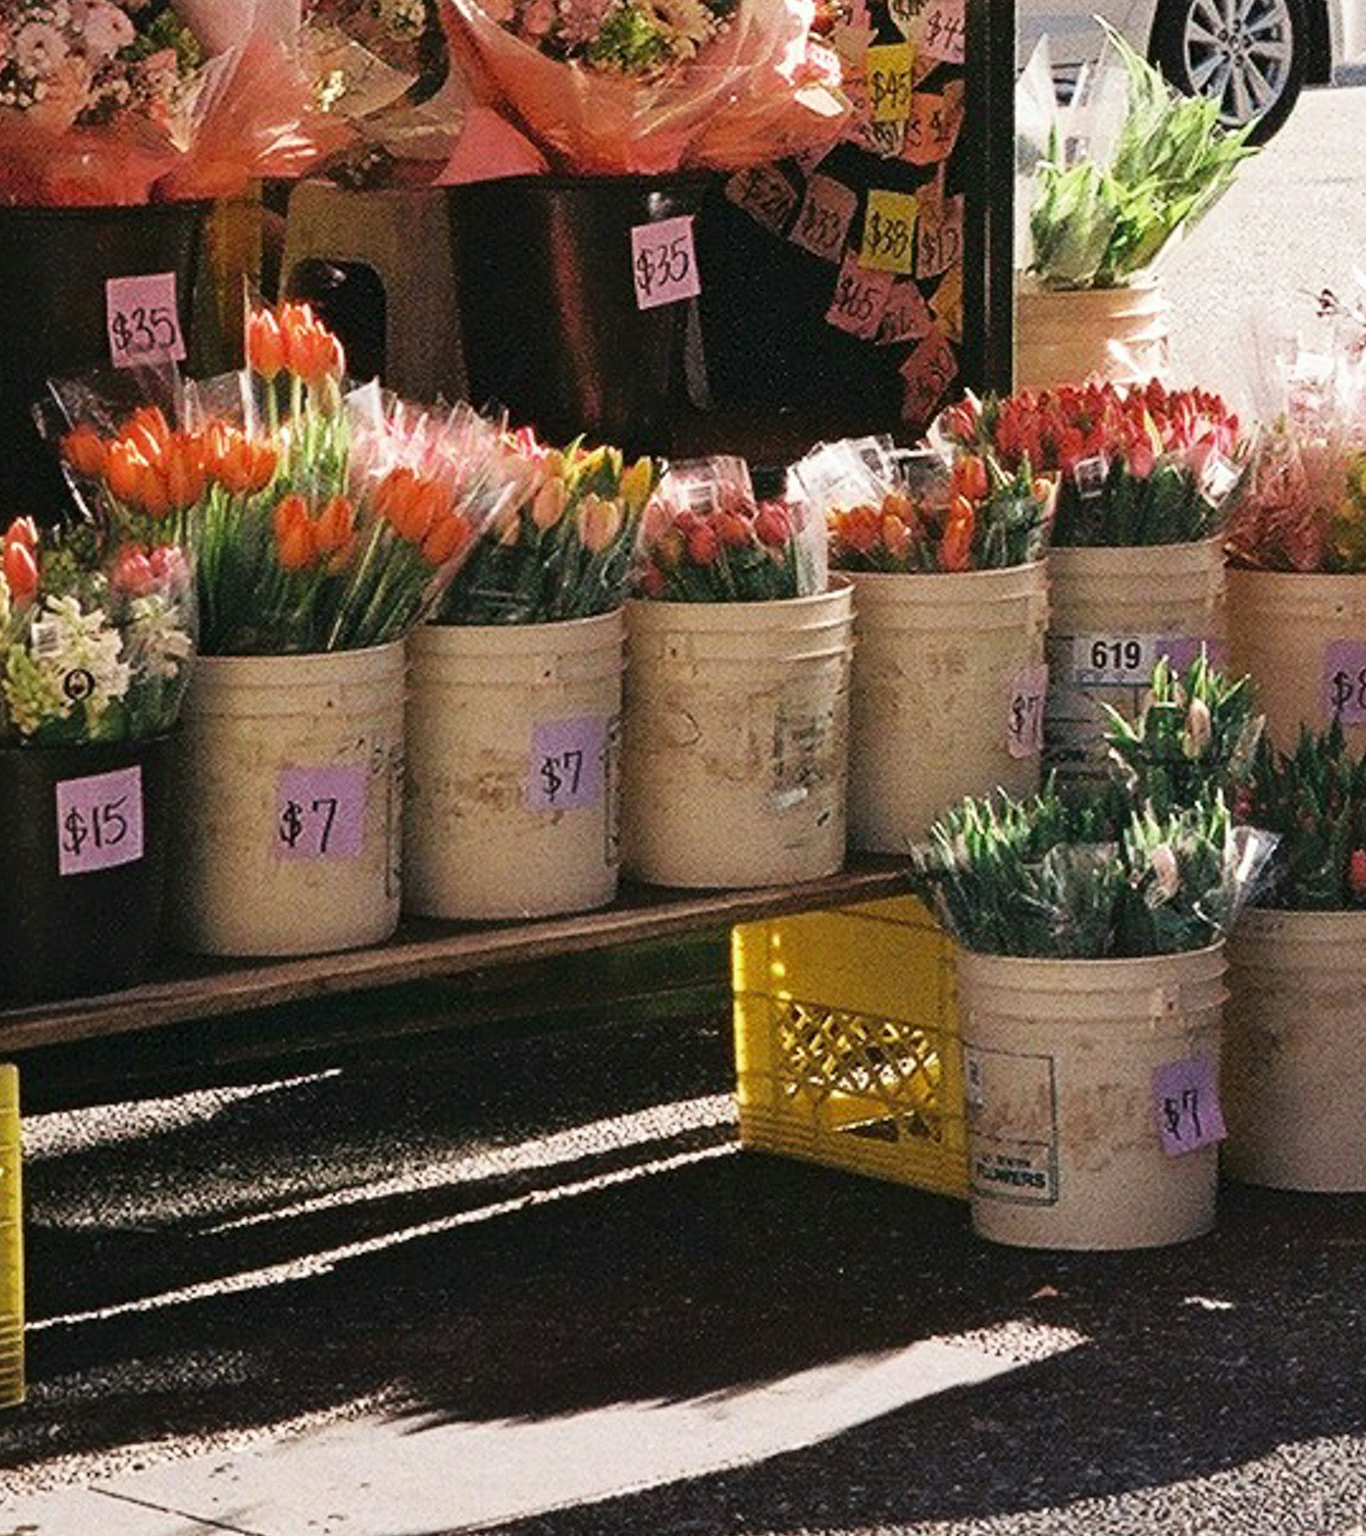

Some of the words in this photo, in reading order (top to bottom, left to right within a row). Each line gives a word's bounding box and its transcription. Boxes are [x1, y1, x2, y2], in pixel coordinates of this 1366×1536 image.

[866, 209, 910, 259] $38
[636, 235, 689, 296] $35
[112, 307, 176, 353] $35
[1091, 640, 1142, 670] 619
[539, 750, 582, 803] $7
[62, 795, 129, 856] $15
[279, 797, 339, 853] $7
[1164, 1088, 1202, 1142] $7
